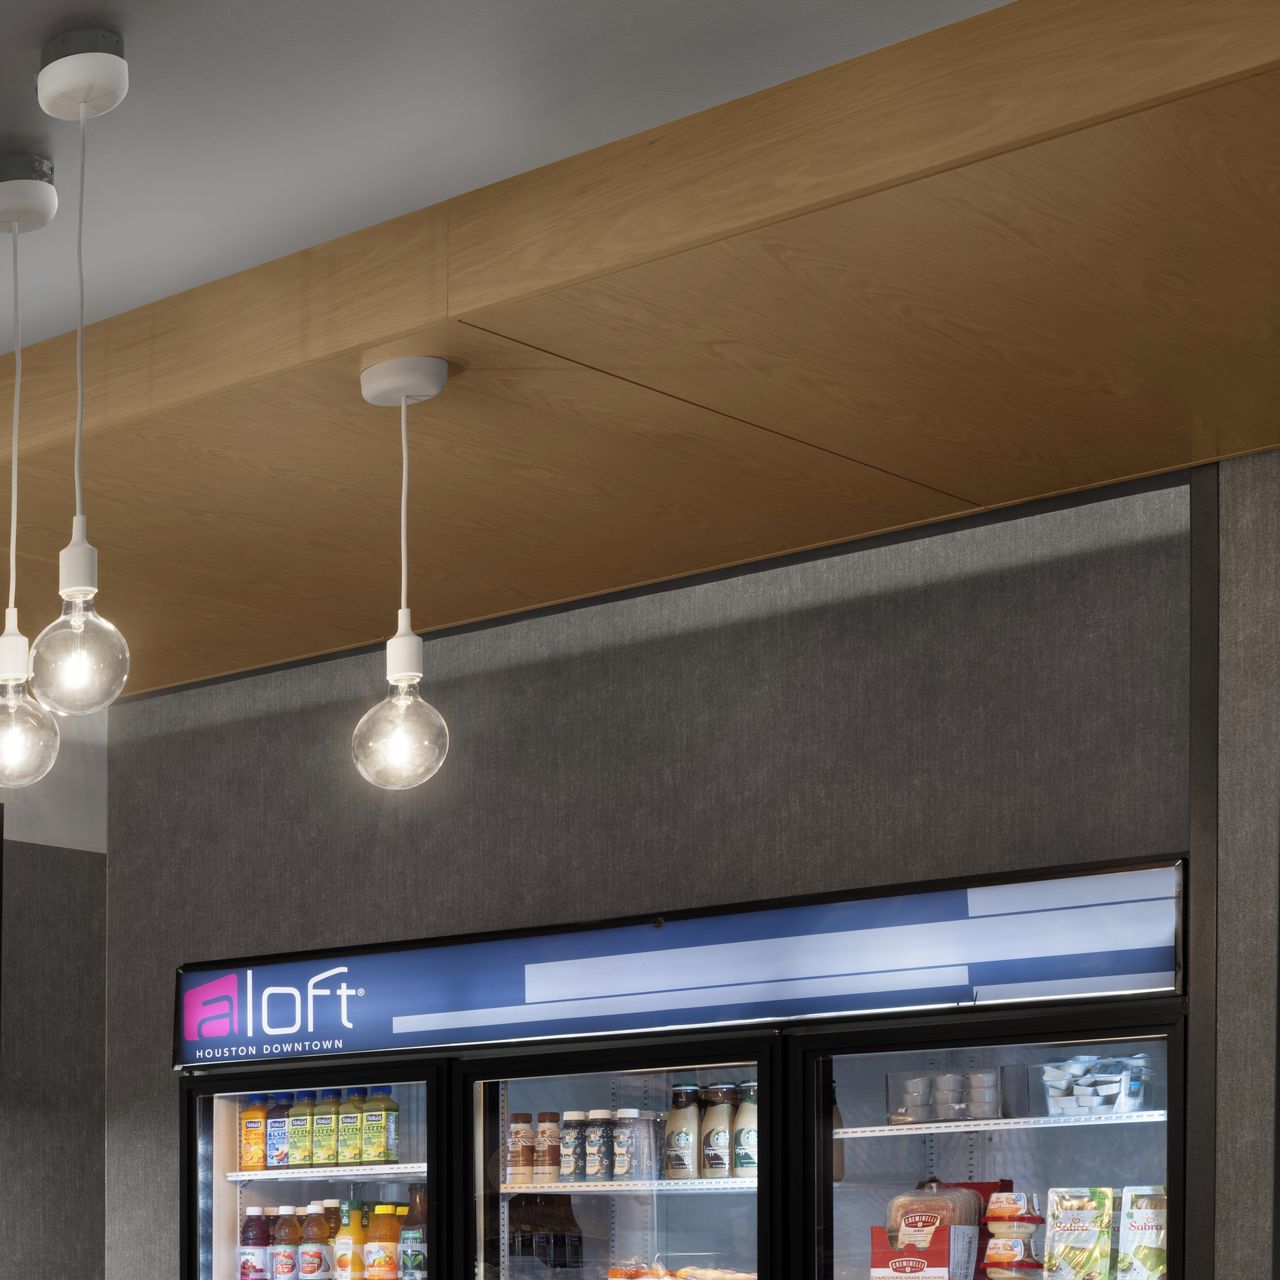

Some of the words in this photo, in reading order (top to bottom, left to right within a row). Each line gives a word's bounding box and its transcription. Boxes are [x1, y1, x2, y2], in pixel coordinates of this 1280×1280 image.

[196, 1046, 256, 1059] HOUSTON
[264, 1039, 343, 1054] DOWNTOWN
[1128, 1221, 1162, 1231] Sabra
